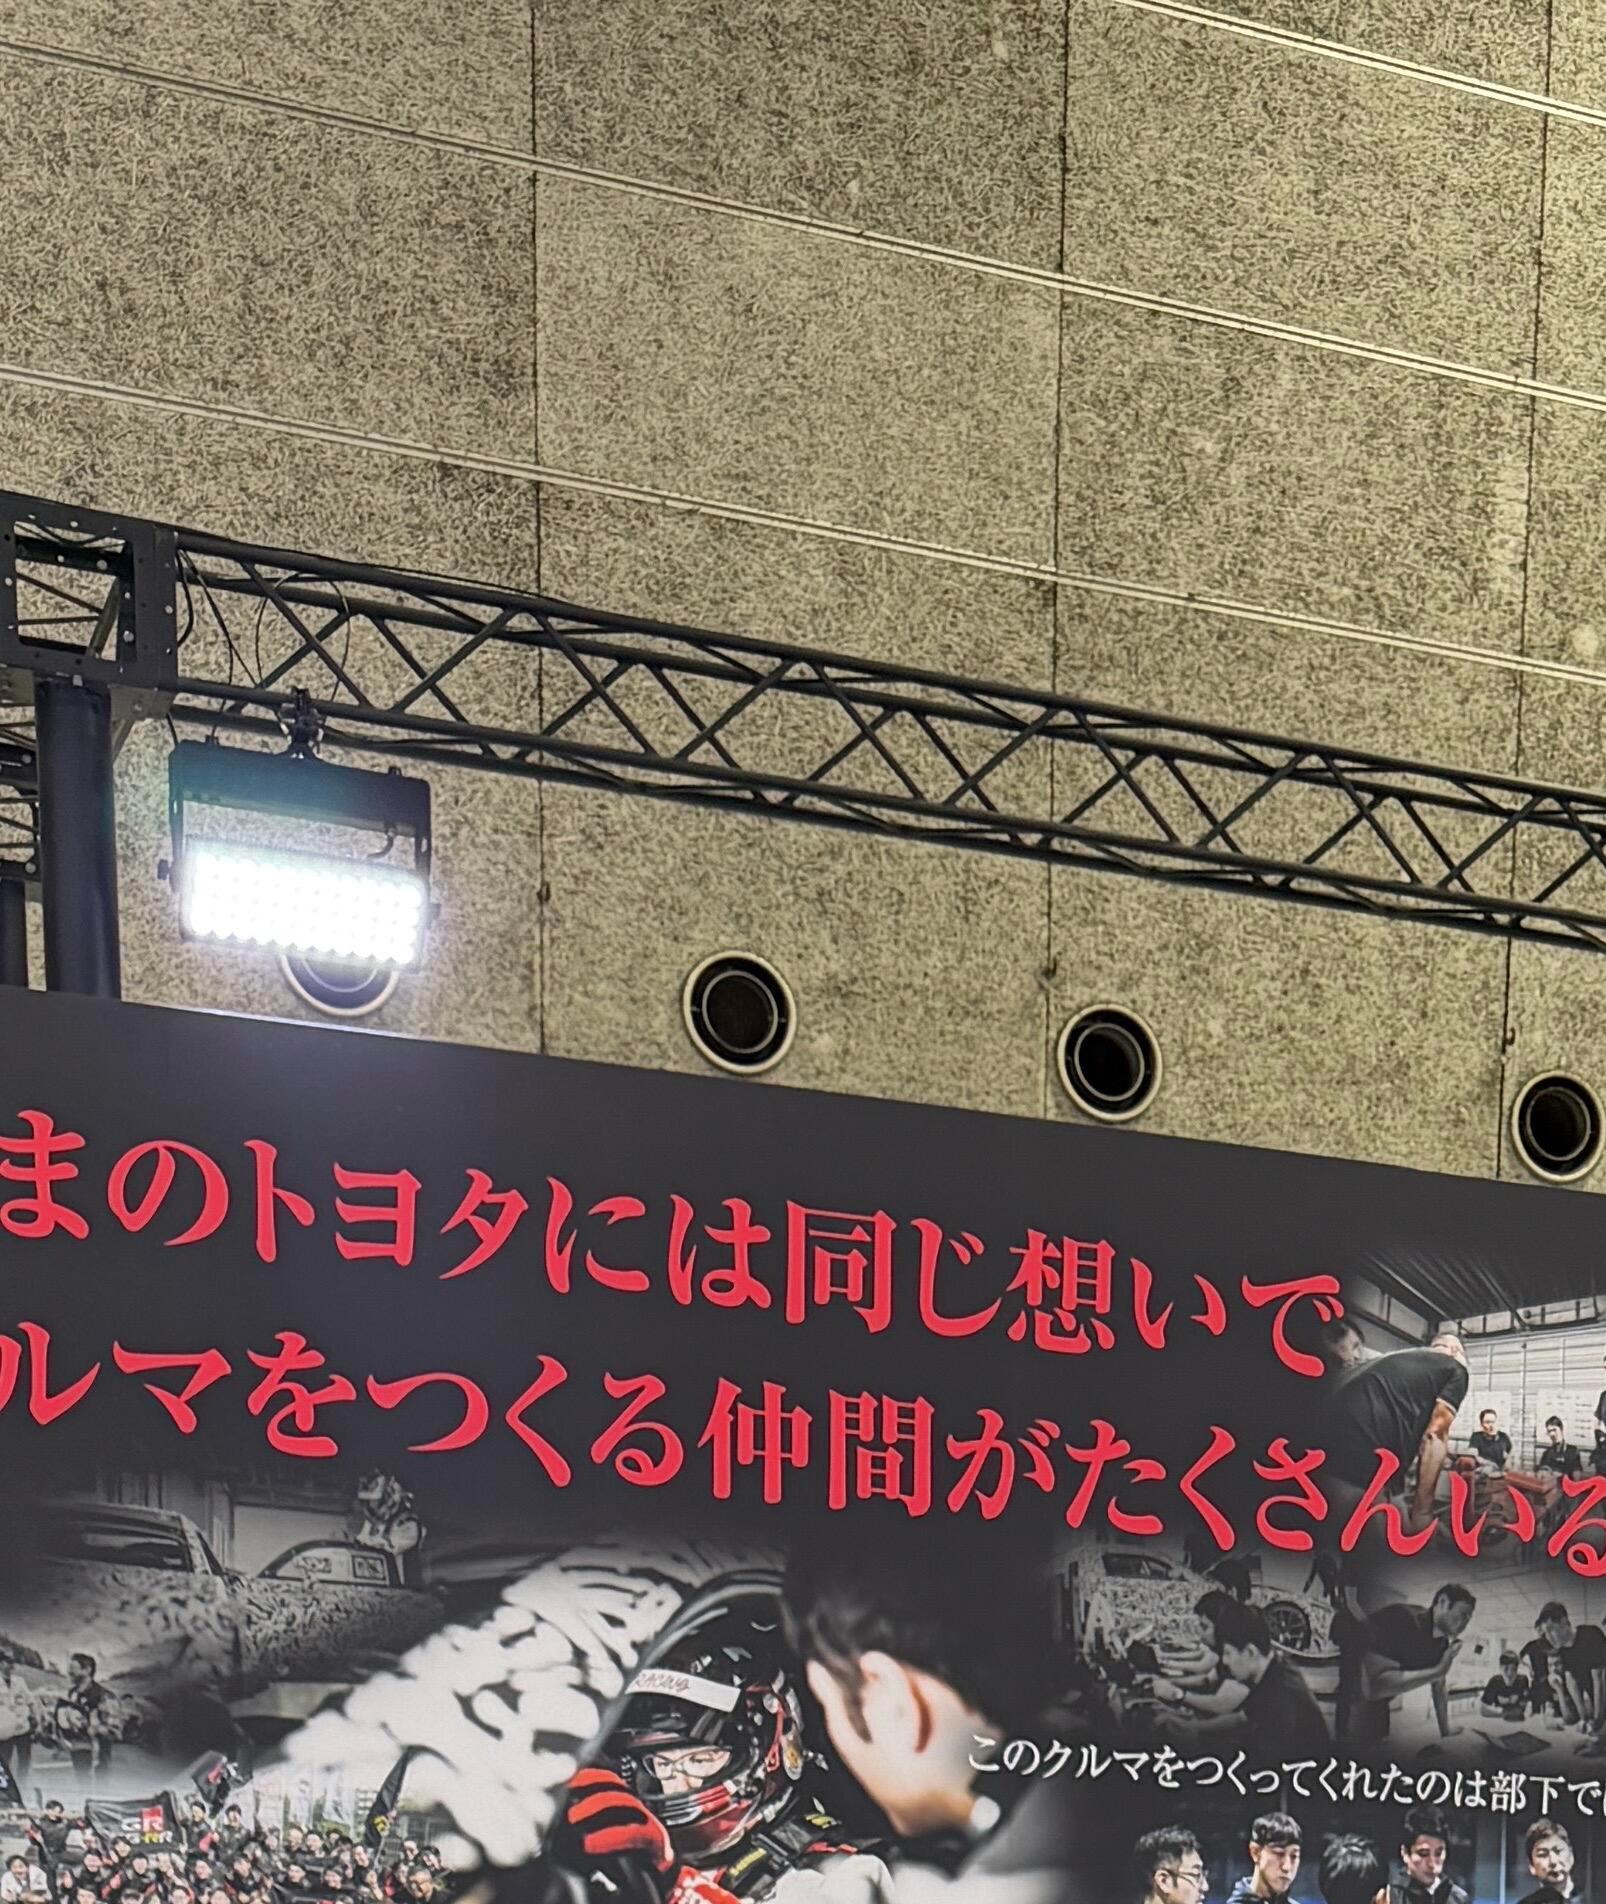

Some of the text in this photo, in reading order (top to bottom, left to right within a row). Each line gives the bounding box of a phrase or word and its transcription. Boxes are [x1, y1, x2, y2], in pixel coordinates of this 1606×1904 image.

[0, 1108, 1345, 1378] まのトヨタには同じ想いで
